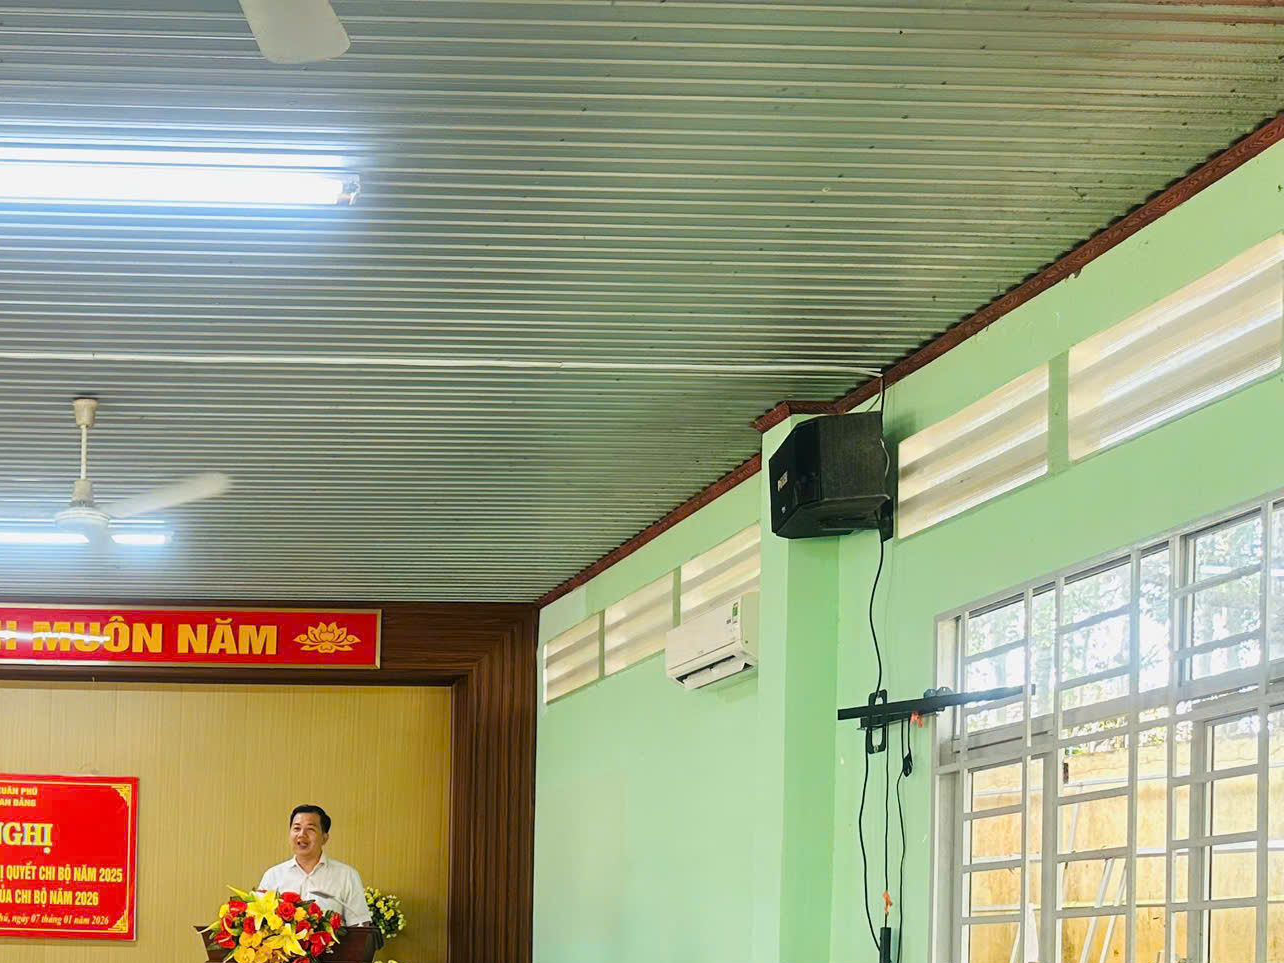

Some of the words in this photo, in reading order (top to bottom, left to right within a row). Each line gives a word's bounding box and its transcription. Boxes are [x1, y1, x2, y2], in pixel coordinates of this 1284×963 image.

[32, 615, 163, 653] MUÔN
[177, 616, 277, 655] NĂM
[6, 861, 37, 881] QUYẾT
[39, 866, 55, 880] CHI
[58, 864, 71, 884] BỘ
[74, 865, 96, 882] NĂM
[99, 868, 123, 882] 2025
[15, 889, 31, 904] CHI
[34, 887, 47, 908] BỘ
[50, 888, 72, 905] NĂM
[75, 891, 99, 906] 2026
[31, 914, 40, 923] 07
[92, 916, 109, 925] 2026
